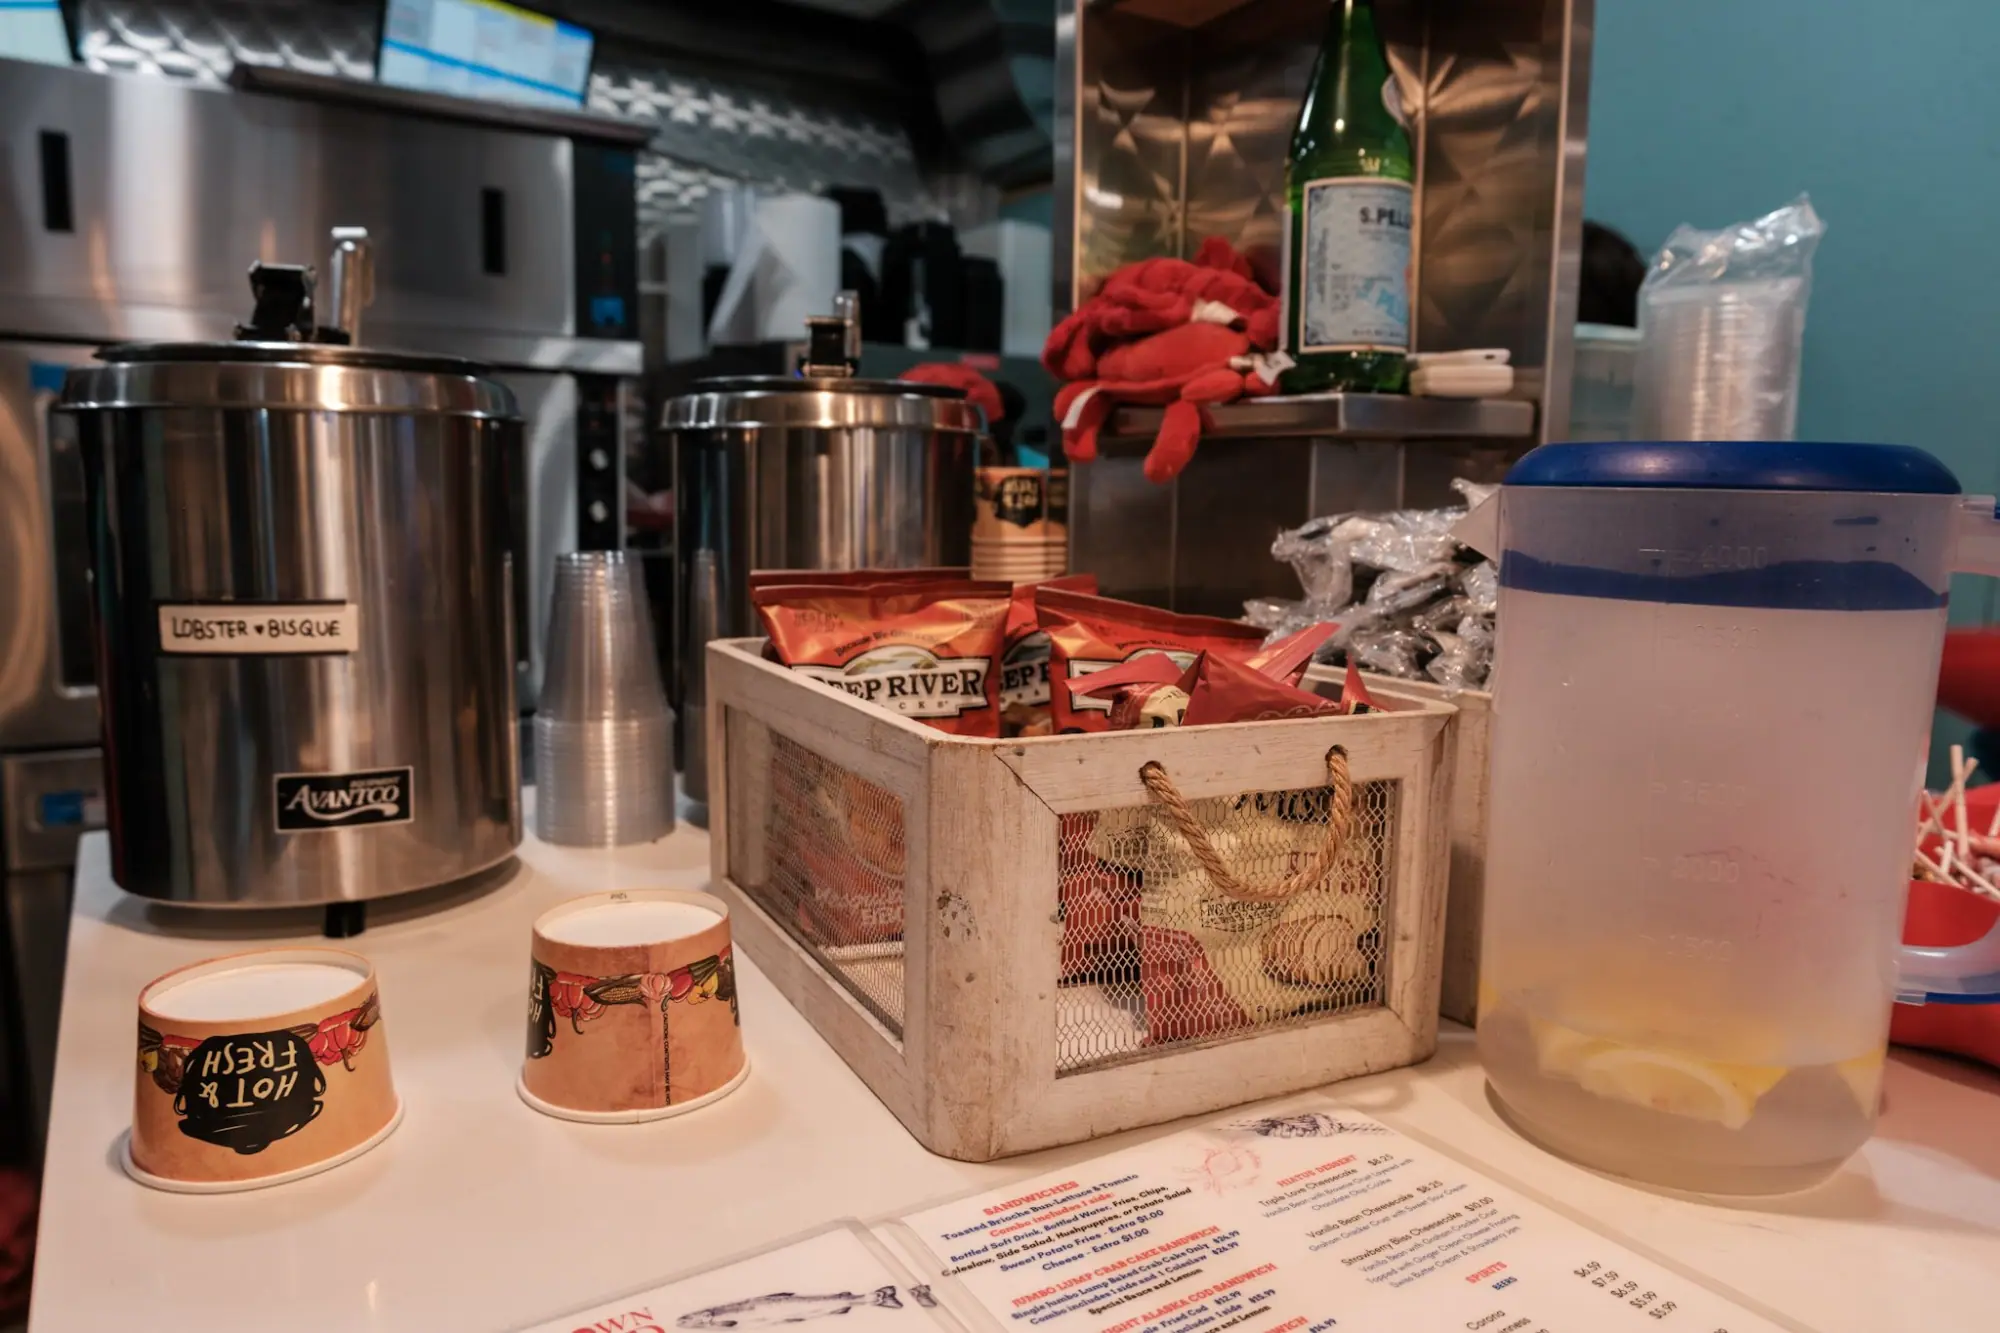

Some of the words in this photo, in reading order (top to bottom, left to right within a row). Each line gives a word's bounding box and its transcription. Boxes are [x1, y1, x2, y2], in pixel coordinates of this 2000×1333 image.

[171, 616, 248, 639] LOBSTER
[267, 618, 341, 638] BISQUE
[808, 676, 882, 701] EP
[886, 668, 983, 698] RIVER
[284, 784, 400, 814] AVANTCO
[201, 1040, 297, 1077] FRESH
[199, 1081, 219, 1108] &
[226, 1070, 299, 1108] HOT
[1276, 1170, 1316, 1187] HIATUS
[1315, 1154, 1357, 1173] DESSERT
[982, 1180, 1079, 1216] SANDWICHES
[1258, 1195, 1286, 1207] Triple
[1284, 1187, 1307, 1198] Love
[1305, 1169, 1358, 1189] Cheesecake
[941, 1223, 988, 1241] Toasted
[987, 1209, 1031, 1227] Brioche
[1030, 1190, 1093, 1214] Bun-Lettuce
[1093, 1184, 1102, 1193] &
[1100, 1173, 1139, 1189] Tomato
[950, 1246, 988, 1263] Bottled
[990, 1238, 1013, 1251] Soft
[1013, 1228, 1043, 1243] Drink,
[1044, 1214, 1079, 1231] Bottled
[1079, 1204, 1113, 1219] Water,
[1112, 1194, 1139, 1208] Fries,
[1139, 1183, 1169, 1199] Chips,
[989, 1220, 1032, 1238] Combo
[1032, 1203, 1082, 1224] includes
[1263, 1205, 1290, 1218] Vanilla
[1288, 1198, 1309, 1209] Bean
[1306, 1221, 1340, 1239] Vanilla
[1337, 1212, 1364, 1227] Bean
[1361, 1192, 1415, 1217] Cheesecake
[941, 1256, 995, 1277] Coleslaw,
[996, 1247, 1020, 1260] Side
[1021, 1235, 1056, 1252] Salad,
[1056, 1214, 1122, 1240] Hushpuppies,
[1123, 1208, 1133, 1216] or
[1134, 1197, 1164, 1212] Potato
[1164, 1186, 1193, 1201] Salad
[1000, 1255, 1037, 1272] Sweet
[1038, 1242, 1074, 1259] Potato
[1074, 1232, 1102, 1247] Fries
[1108, 1220, 1137, 1234] Extra
[1136, 1208, 1165, 1224] $1.00
[1341, 1241, 1393, 1267] Strawberry
[1409, 1211, 1463, 1236] Cheesecake
[1464, 1196, 1494, 1212] $10.00
[1438, 1238, 1464, 1252] Cream
[1462, 1226, 1491, 1240] Cheese
[1011, 1286, 1057, 1307] JUMBO
[1057, 1272, 1094, 1290] LUMP
[1093, 1260, 1128, 1277] CRAB
[1126, 1246, 1160, 1265] CAKE
[1158, 1225, 1221, 1253] SANDWICH
[1042, 1253, 1085, 1271] Cheese
[1091, 1239, 1121, 1254] Extra
[1121, 1227, 1150, 1243] $1.00
[1385, 1248, 1409, 1261] Bean
[1409, 1242, 1424, 1253] with
[1011, 1304, 1047, 1320] Single
[1079, 1280, 1109, 1296] Lump
[1108, 1268, 1139, 1284] Baked
[1139, 1260, 1162, 1273] Crab
[1162, 1250, 1187, 1263] Cake
[1185, 1243, 1210, 1254] Only
[1465, 1260, 1508, 1284] SPIRITS
[1492, 1276, 1519, 1291] BEERS
[1573, 1260, 1603, 1279] $6.59
[1592, 1270, 1620, 1289] $7.59
[1030, 1308, 1067, 1325] Combo
[1067, 1291, 1110, 1312] includes
[1116, 1280, 1138, 1292] side
[1138, 1273, 1157, 1285] and
[1165, 1254, 1208, 1273] Coleslaw
[1088, 1297, 1126, 1315] Special
[1124, 1287, 1153, 1301] Sauce
[1153, 1279, 1172, 1291] and
[1170, 1269, 1204, 1283] Lemon
[1141, 1299, 1191, 1323] ALASKA
[1187, 1284, 1214, 1303] COD
[1213, 1263, 1279, 1293] SANDWICH
[1610, 1280, 1639, 1299] $6.59
[1629, 1290, 1658, 1309] $5.99
[1159, 1313, 1189, 1328] Fried
[1187, 1304, 1209, 1317] Cod
[1214, 1290, 1242, 1305] $12.99
[1220, 1317, 1241, 1329] and
[1238, 1305, 1272, 1321] Lemon
[1221, 1304, 1243, 1315] side
[1466, 1310, 1506, 1331] Corona
[1648, 1301, 1678, 1320] $5.99
